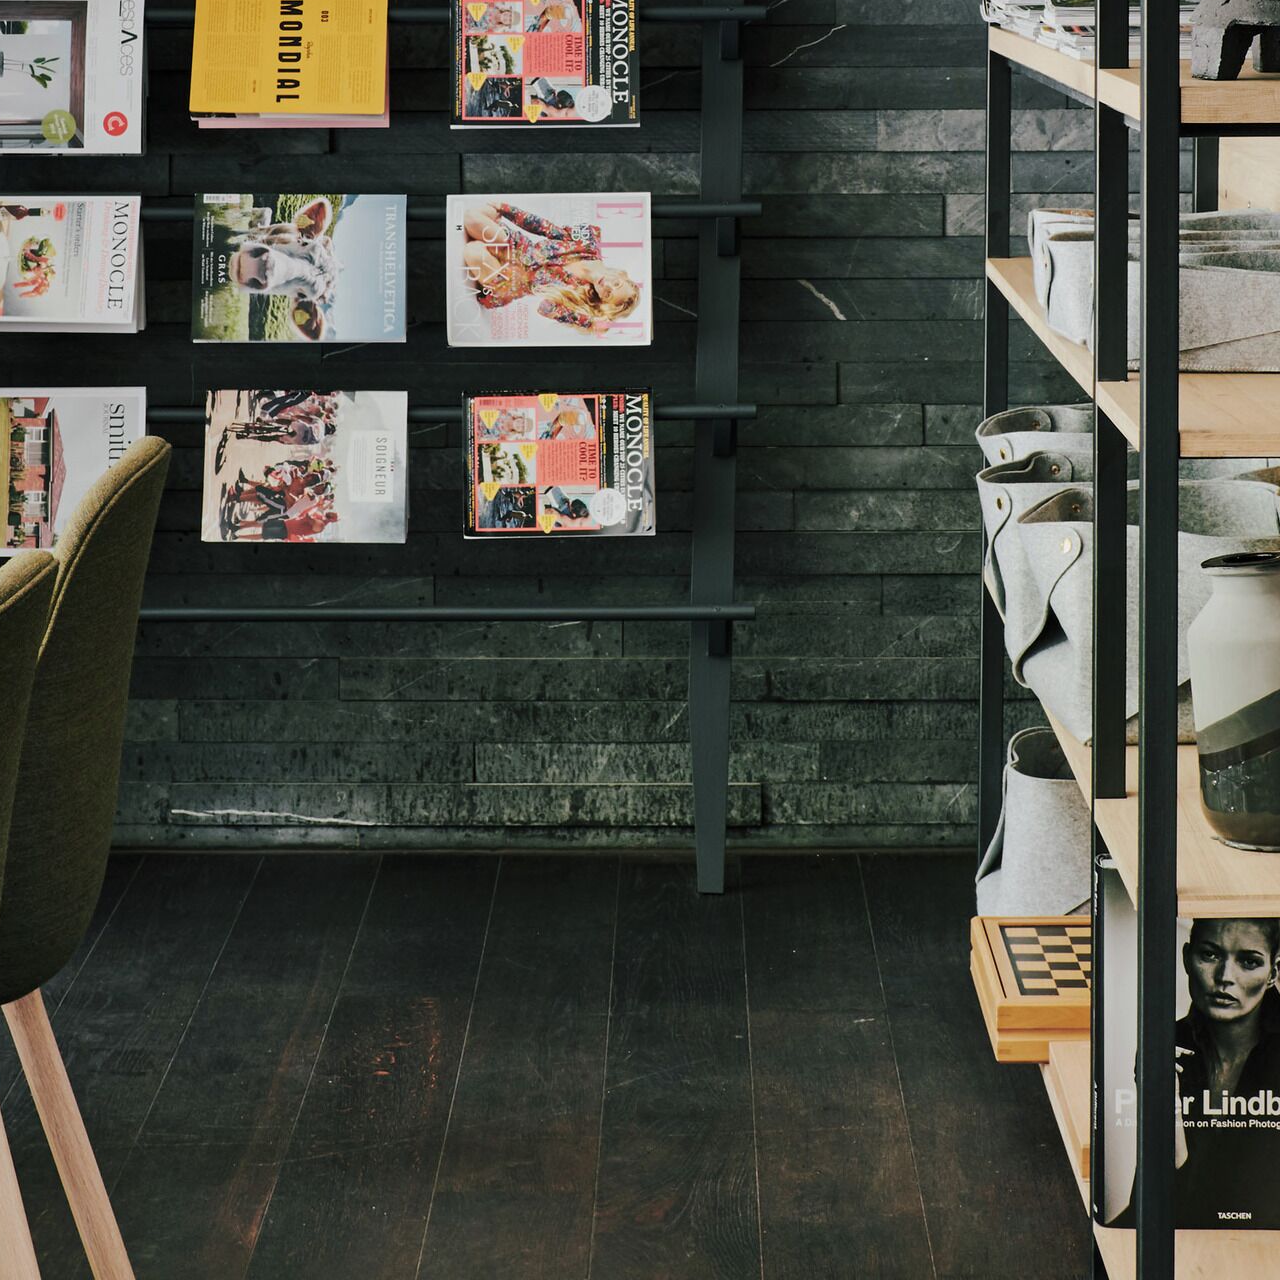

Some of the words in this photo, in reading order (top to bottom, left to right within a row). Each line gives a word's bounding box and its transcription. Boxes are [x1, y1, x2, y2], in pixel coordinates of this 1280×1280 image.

[276, 0, 304, 104] MONDIAL
[565, 34, 574, 58] COOL
[574, 35, 582, 58] TIME
[574, 60, 582, 71] TO
[107, 201, 130, 310] MONOCLE
[218, 254, 226, 284] GRAS
[579, 441, 587, 466] COOL
[588, 443, 597, 467] TIME
[625, 394, 642, 512] MONOCLE
[375, 437, 388, 496] SOIGNEUR
[588, 468, 597, 479] TO
[1197, 1121, 1209, 1129] on
[1210, 1119, 1248, 1129] Fashion
[1217, 1212, 1252, 1221] TASCHEN
